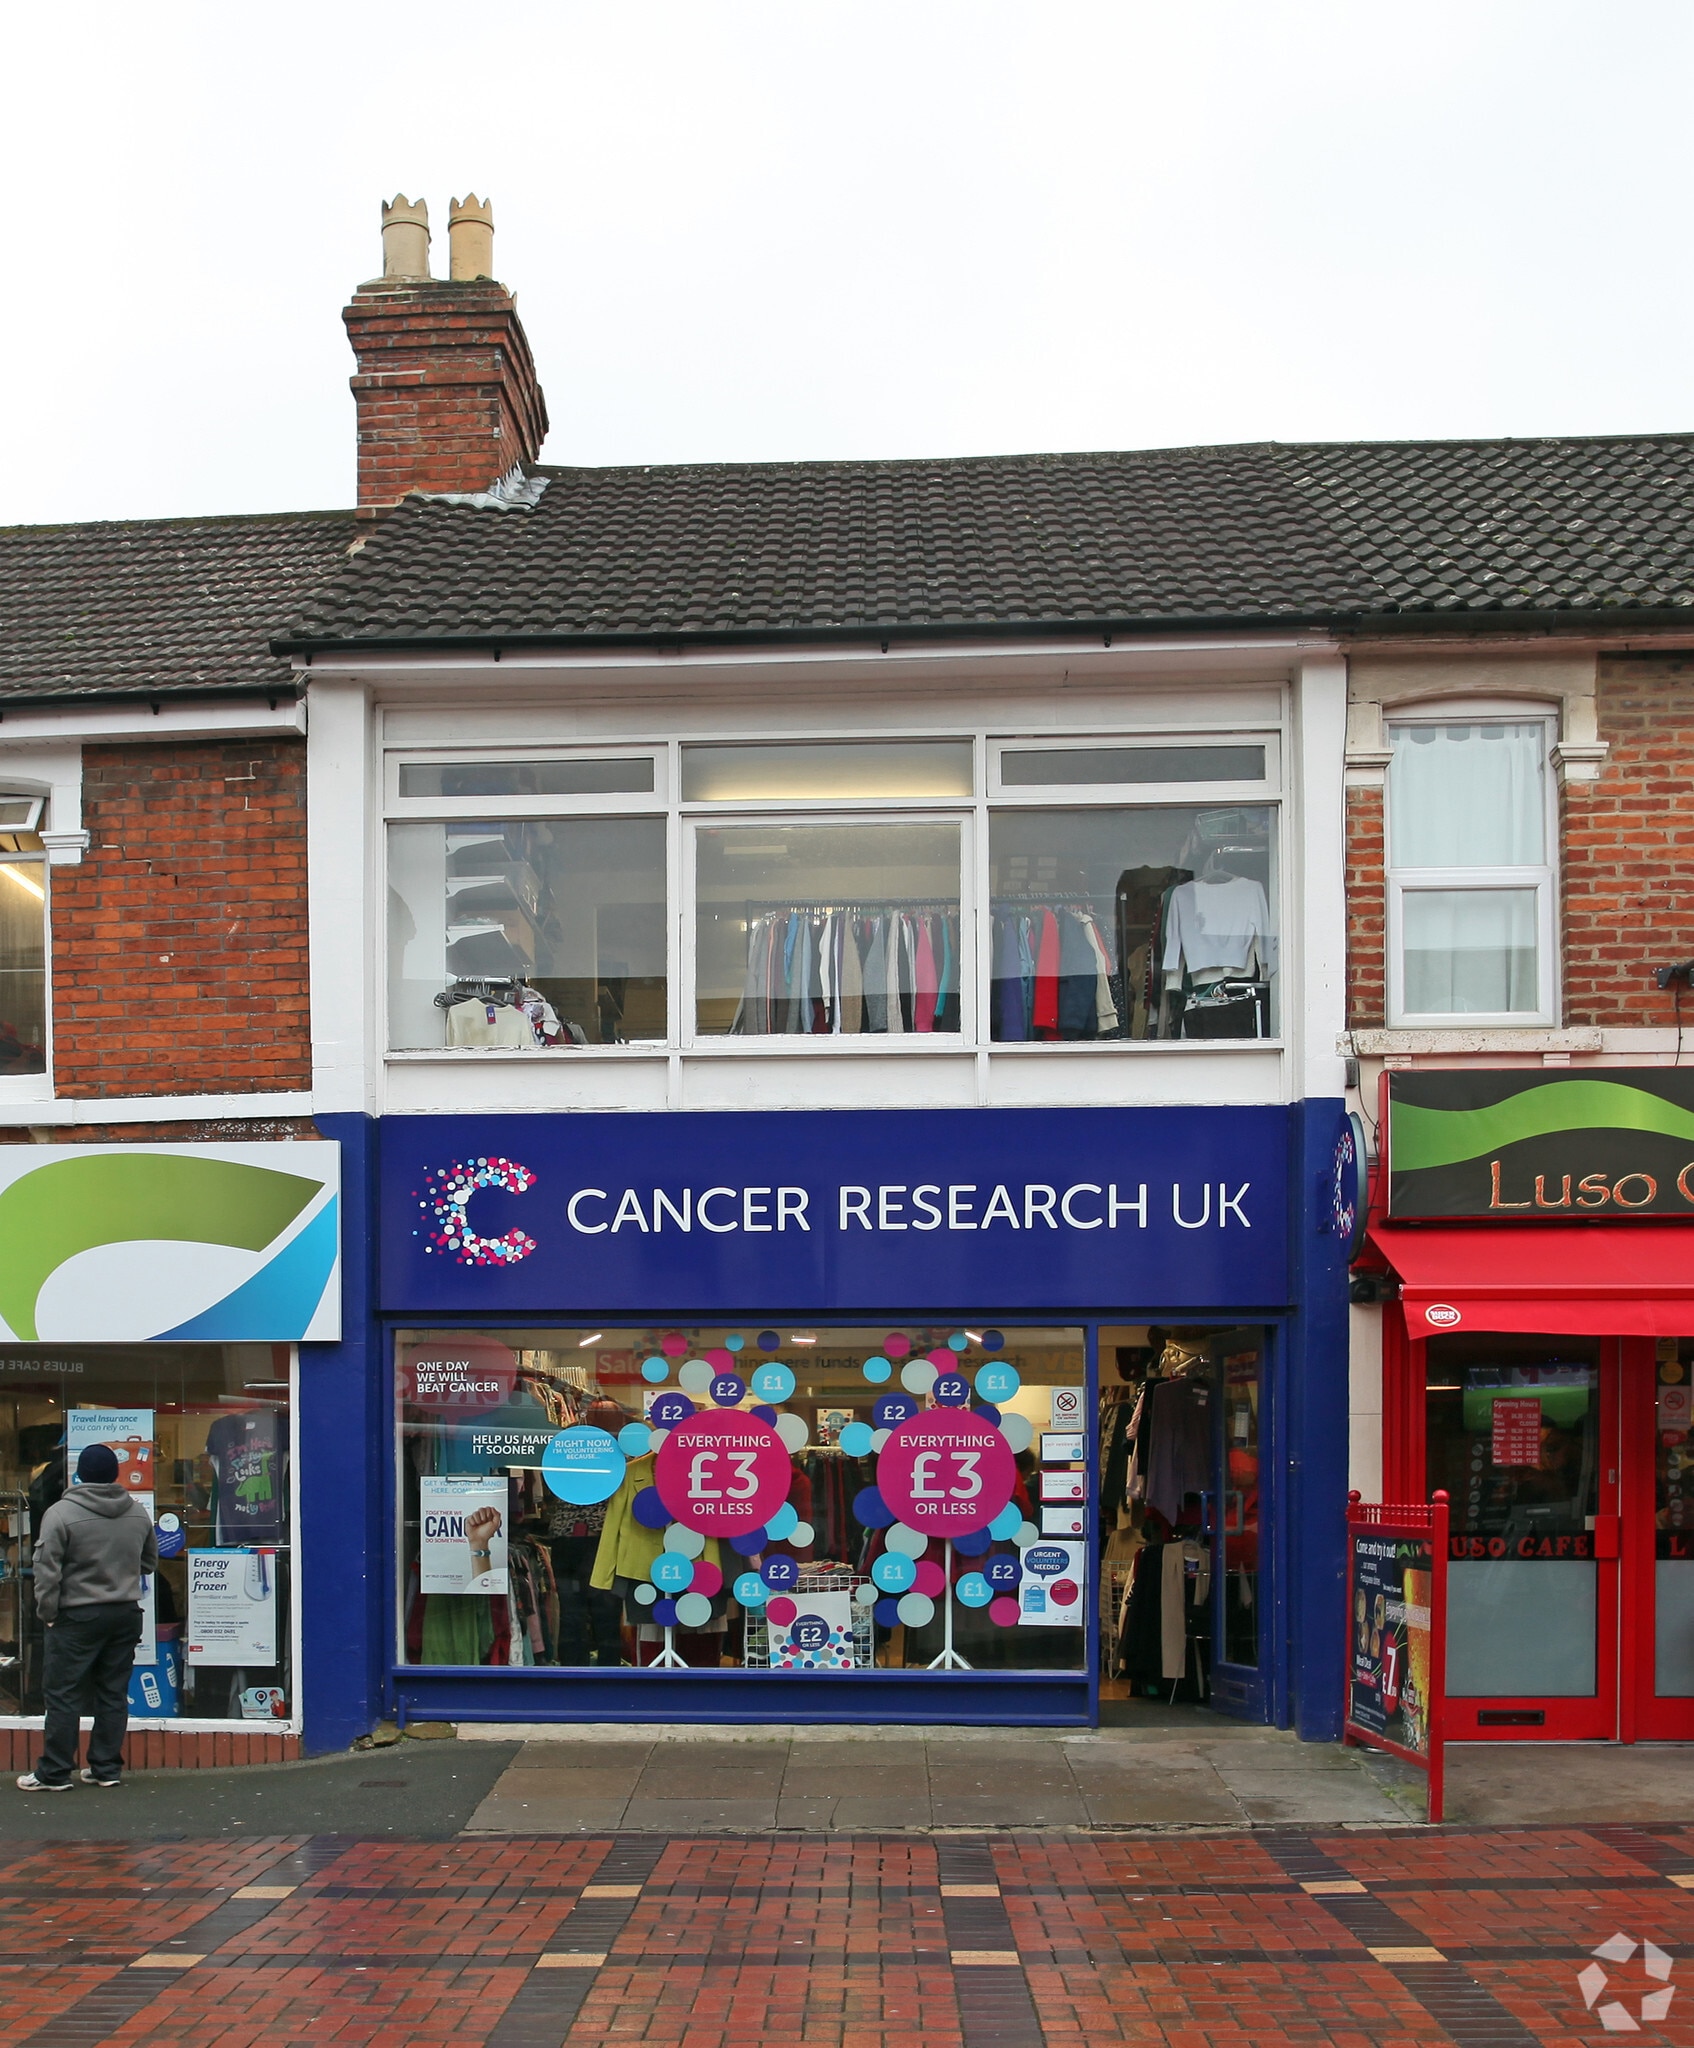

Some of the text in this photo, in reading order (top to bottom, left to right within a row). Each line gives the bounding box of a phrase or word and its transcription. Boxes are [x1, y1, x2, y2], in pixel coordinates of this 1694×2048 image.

[567, 1183, 1252, 1234] CANCER RESEARCH UK
[416, 1361, 469, 1371] ONE DAY
[416, 1372, 467, 1382] WE WILL
[763, 1376, 784, 1390] £1
[987, 1375, 1008, 1390] £1
[417, 1382, 499, 1393] BEAT CANCER
[716, 1382, 738, 1396] £2
[939, 1382, 961, 1396] £2
[1494, 1400, 1519, 1408] Opening
[661, 1406, 683, 1420] £2
[883, 1406, 906, 1420] £2
[71, 1424, 85, 1433] you
[103, 1423, 117, 1432] rely
[473, 1435, 501, 1444] HELP
[505, 1435, 520, 1444] US
[555, 1439, 611, 1449] RIGHT NOW
[678, 1436, 771, 1447] EVERYTHING
[900, 1435, 995, 1447] EVERYTHING
[473, 1445, 535, 1455] IT SOONER
[687, 1451, 759, 1499] £3
[909, 1451, 983, 1499] £3
[693, 1503, 753, 1515] OR LESS
[915, 1503, 977, 1515] OR LESS
[1356, 1539, 1368, 1555] Come
[1368, 1541, 1377, 1556] and
[1451, 1535, 1588, 1557] USO CAFE
[194, 1558, 229, 1569] Energy
[194, 1568, 225, 1580] prices
[661, 1565, 682, 1580] £1
[768, 1565, 790, 1579] £2
[883, 1565, 904, 1580] £1
[991, 1565, 1014, 1579] £2
[741, 1582, 761, 1597] £1
[964, 1582, 984, 1597] £1
[800, 1627, 822, 1642] £2
